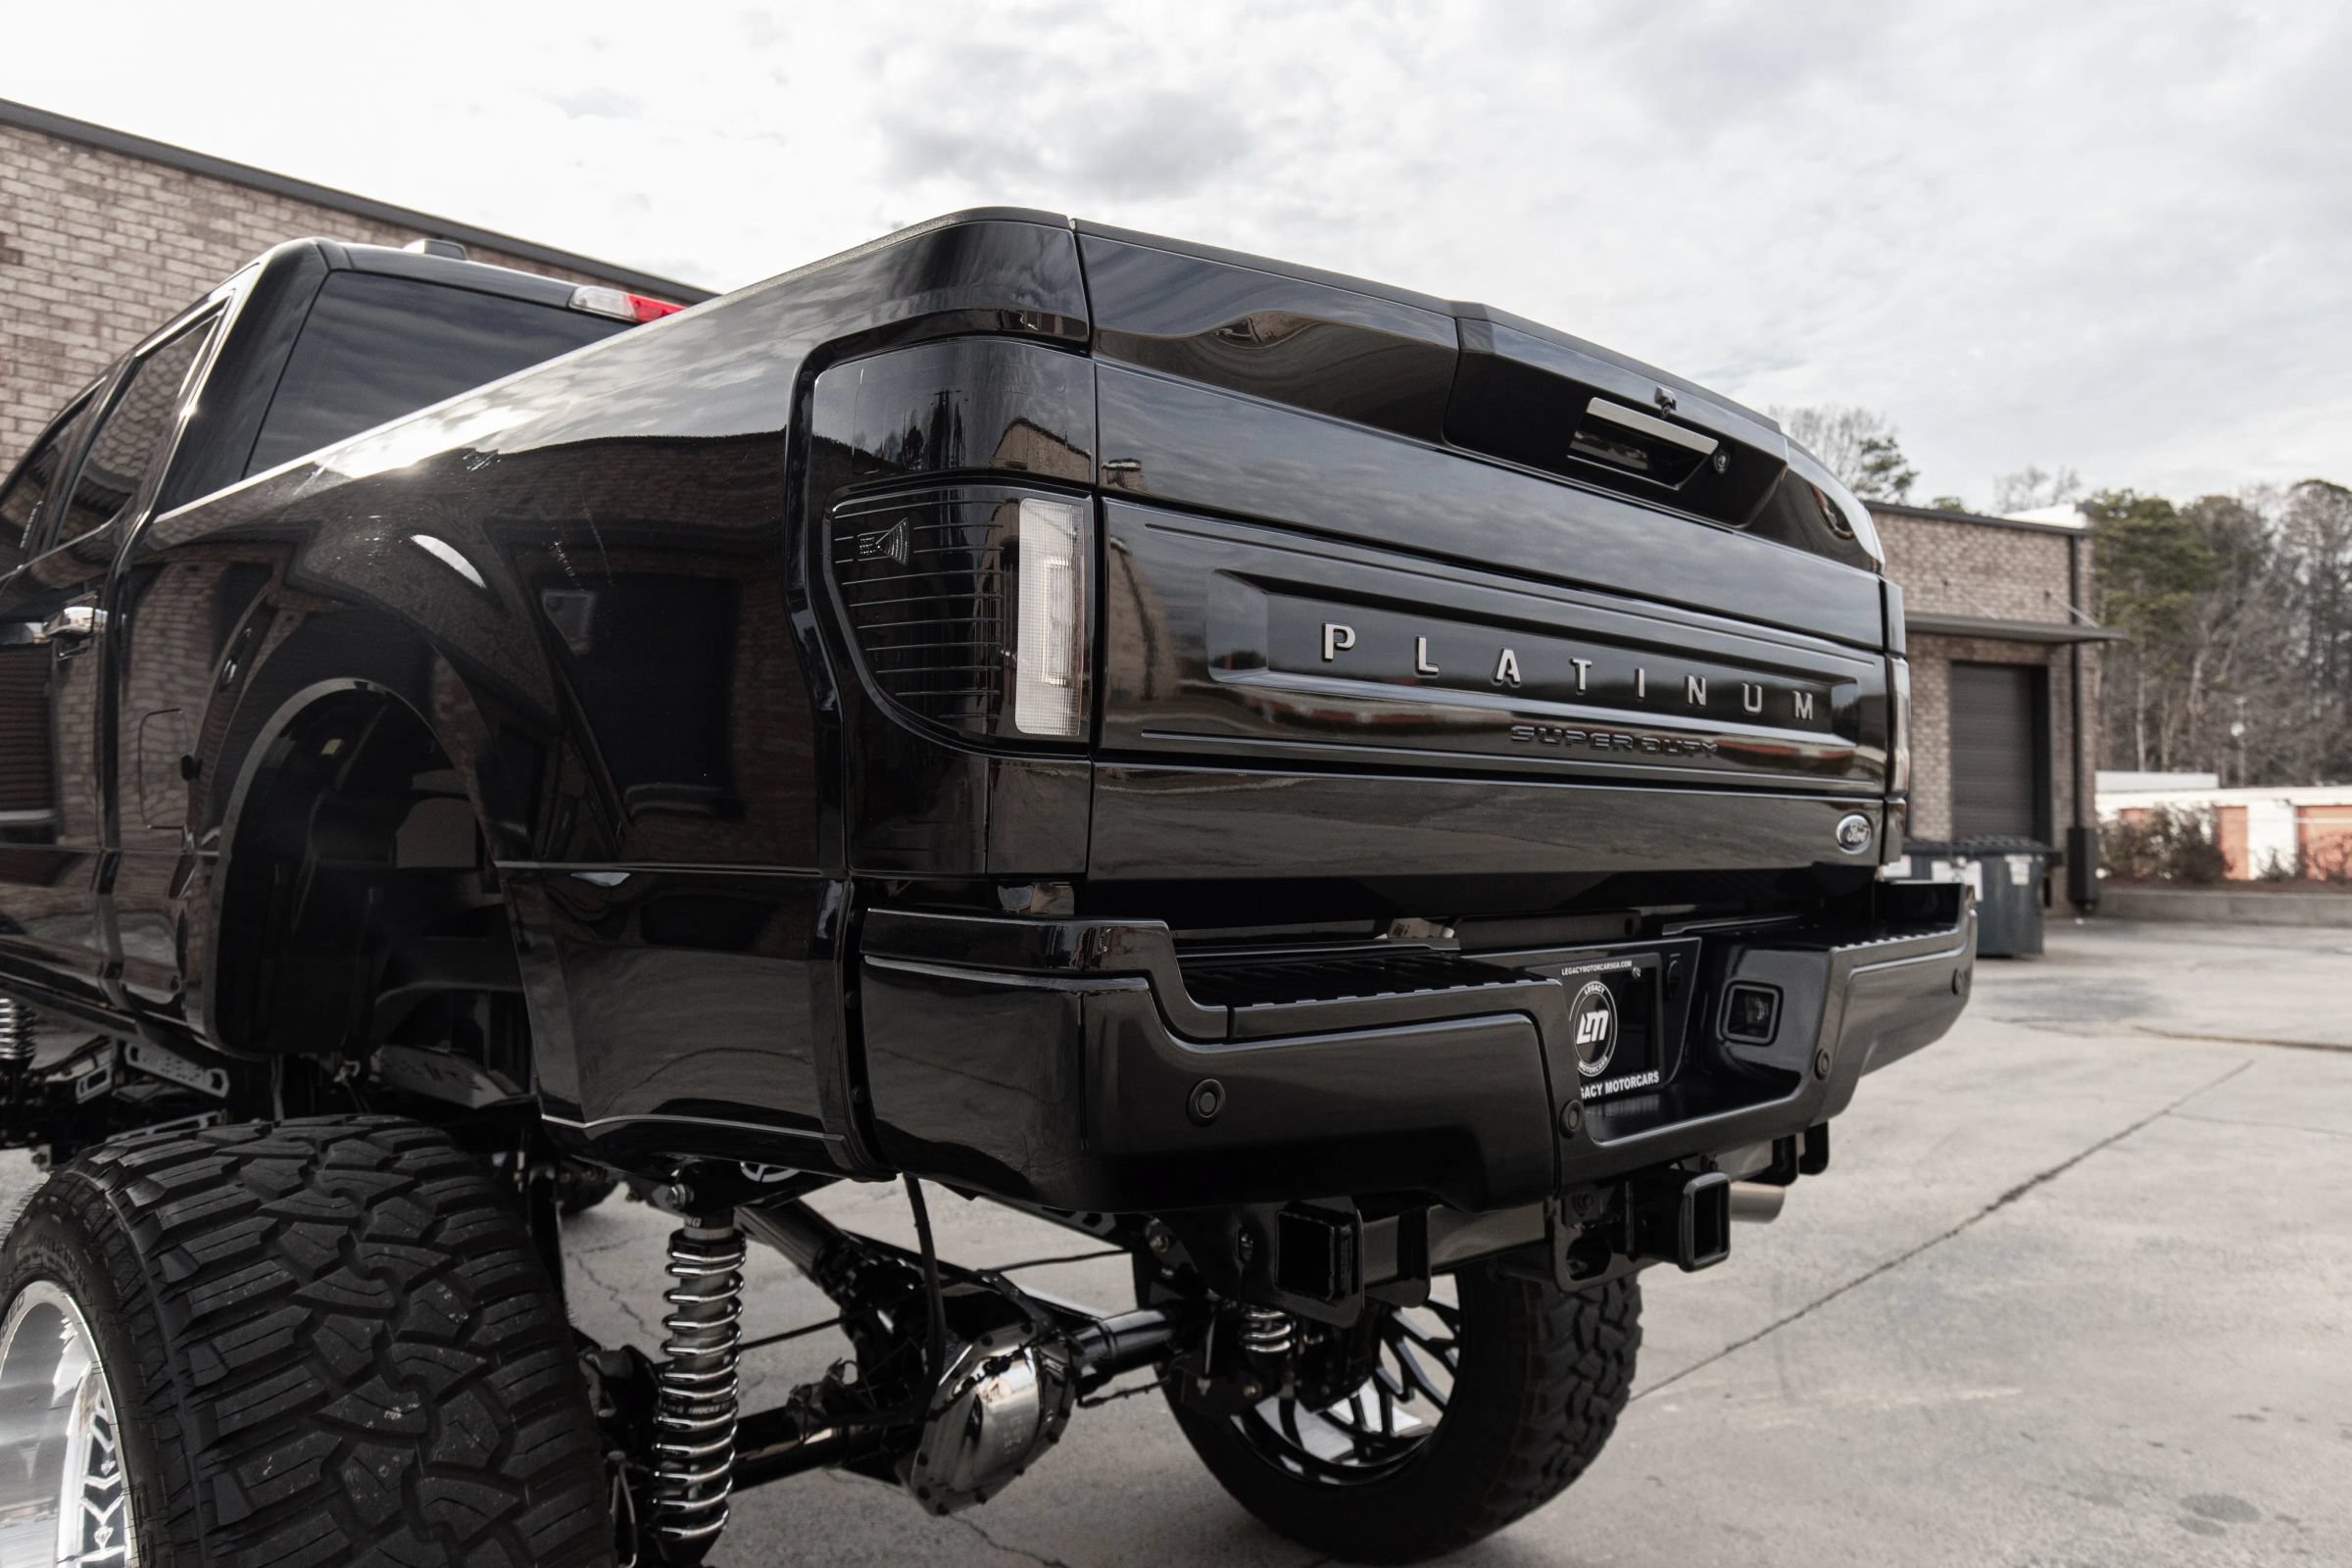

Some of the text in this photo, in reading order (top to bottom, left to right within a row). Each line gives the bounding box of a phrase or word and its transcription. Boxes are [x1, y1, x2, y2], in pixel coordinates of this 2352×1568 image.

[1321, 621, 1815, 720] PLATINUM
[1510, 724, 1718, 759] SUPER DUTY
[1561, 960, 1633, 976] LEGACYMOTORCARSGA.COM
[1584, 984, 1605, 996] LEGACY
[1579, 1056, 1608, 1074] MOTORCARS
[1581, 1071, 1659, 1100] GACY MOTORCARS
